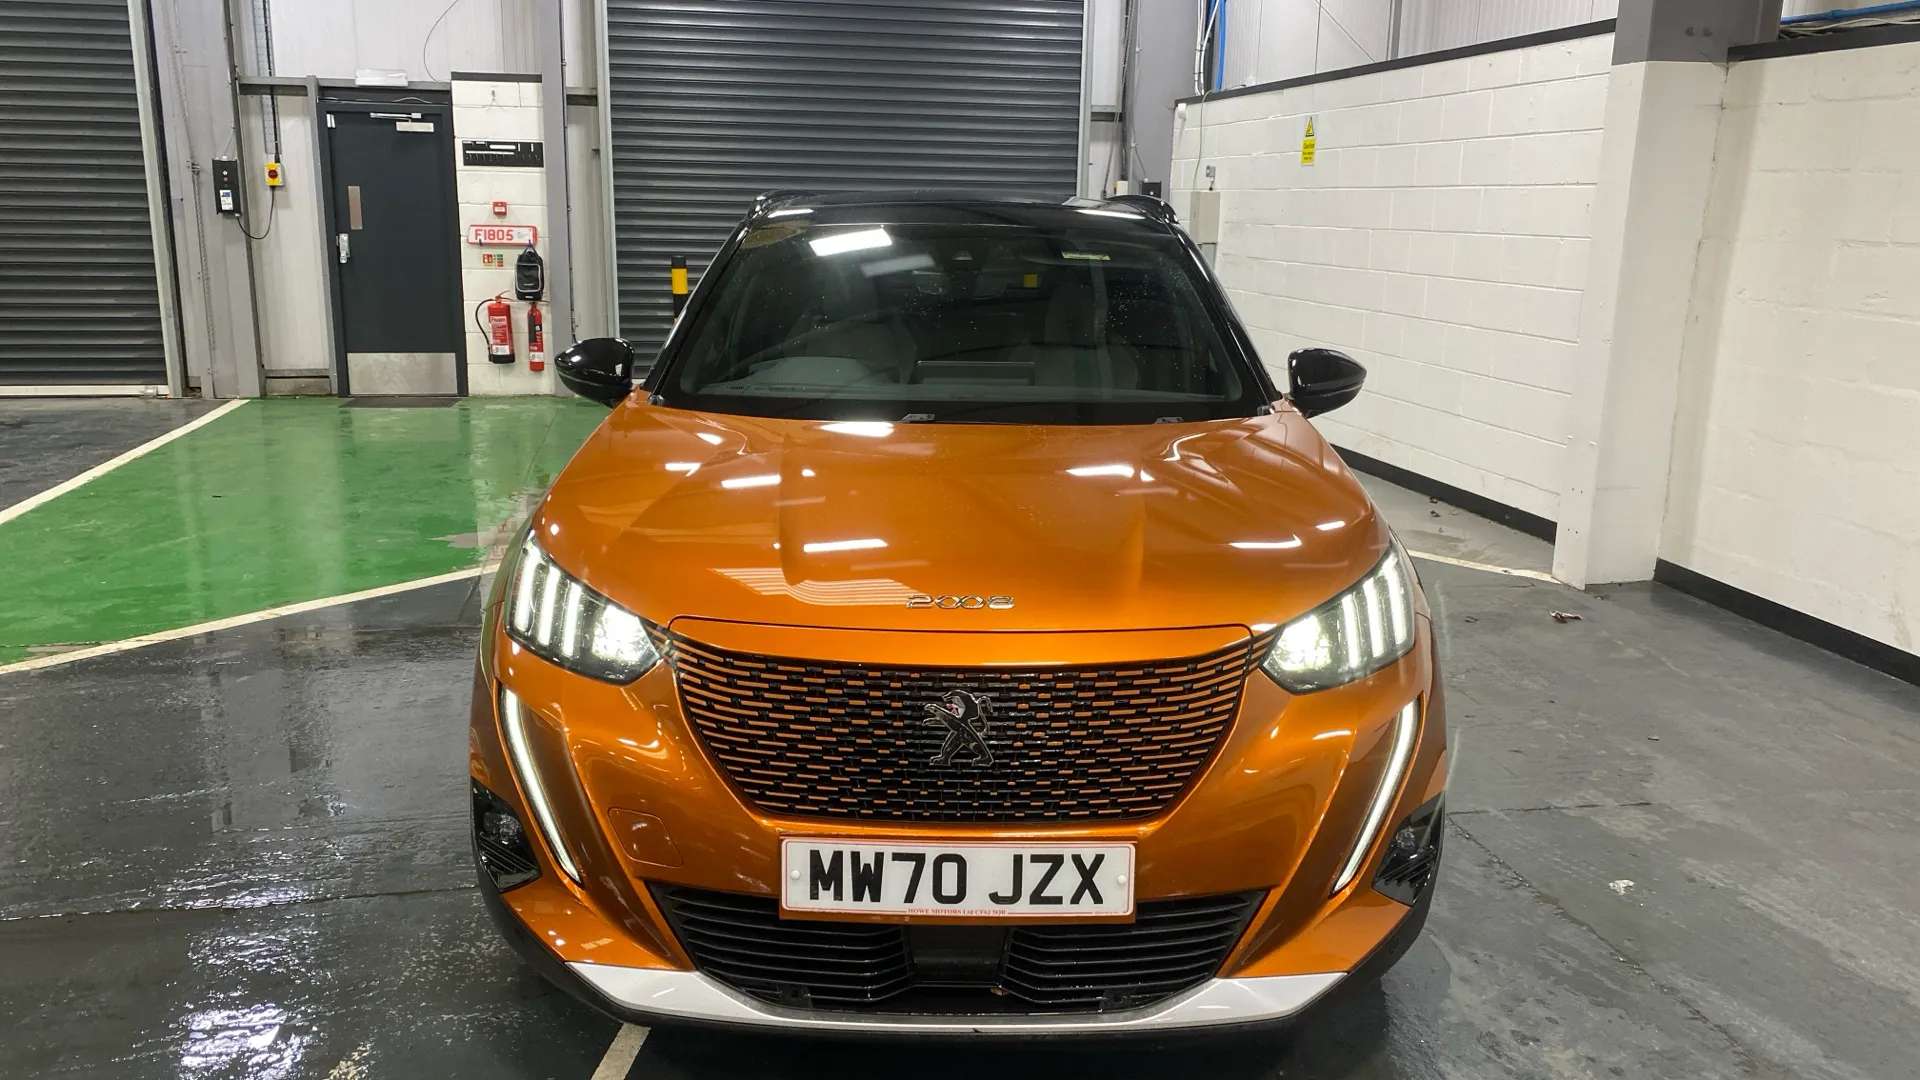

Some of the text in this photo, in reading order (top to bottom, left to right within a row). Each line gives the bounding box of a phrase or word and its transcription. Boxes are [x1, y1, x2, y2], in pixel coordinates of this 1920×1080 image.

[906, 595, 1015, 609] 2008
[809, 849, 1105, 905] MW70 JZX
